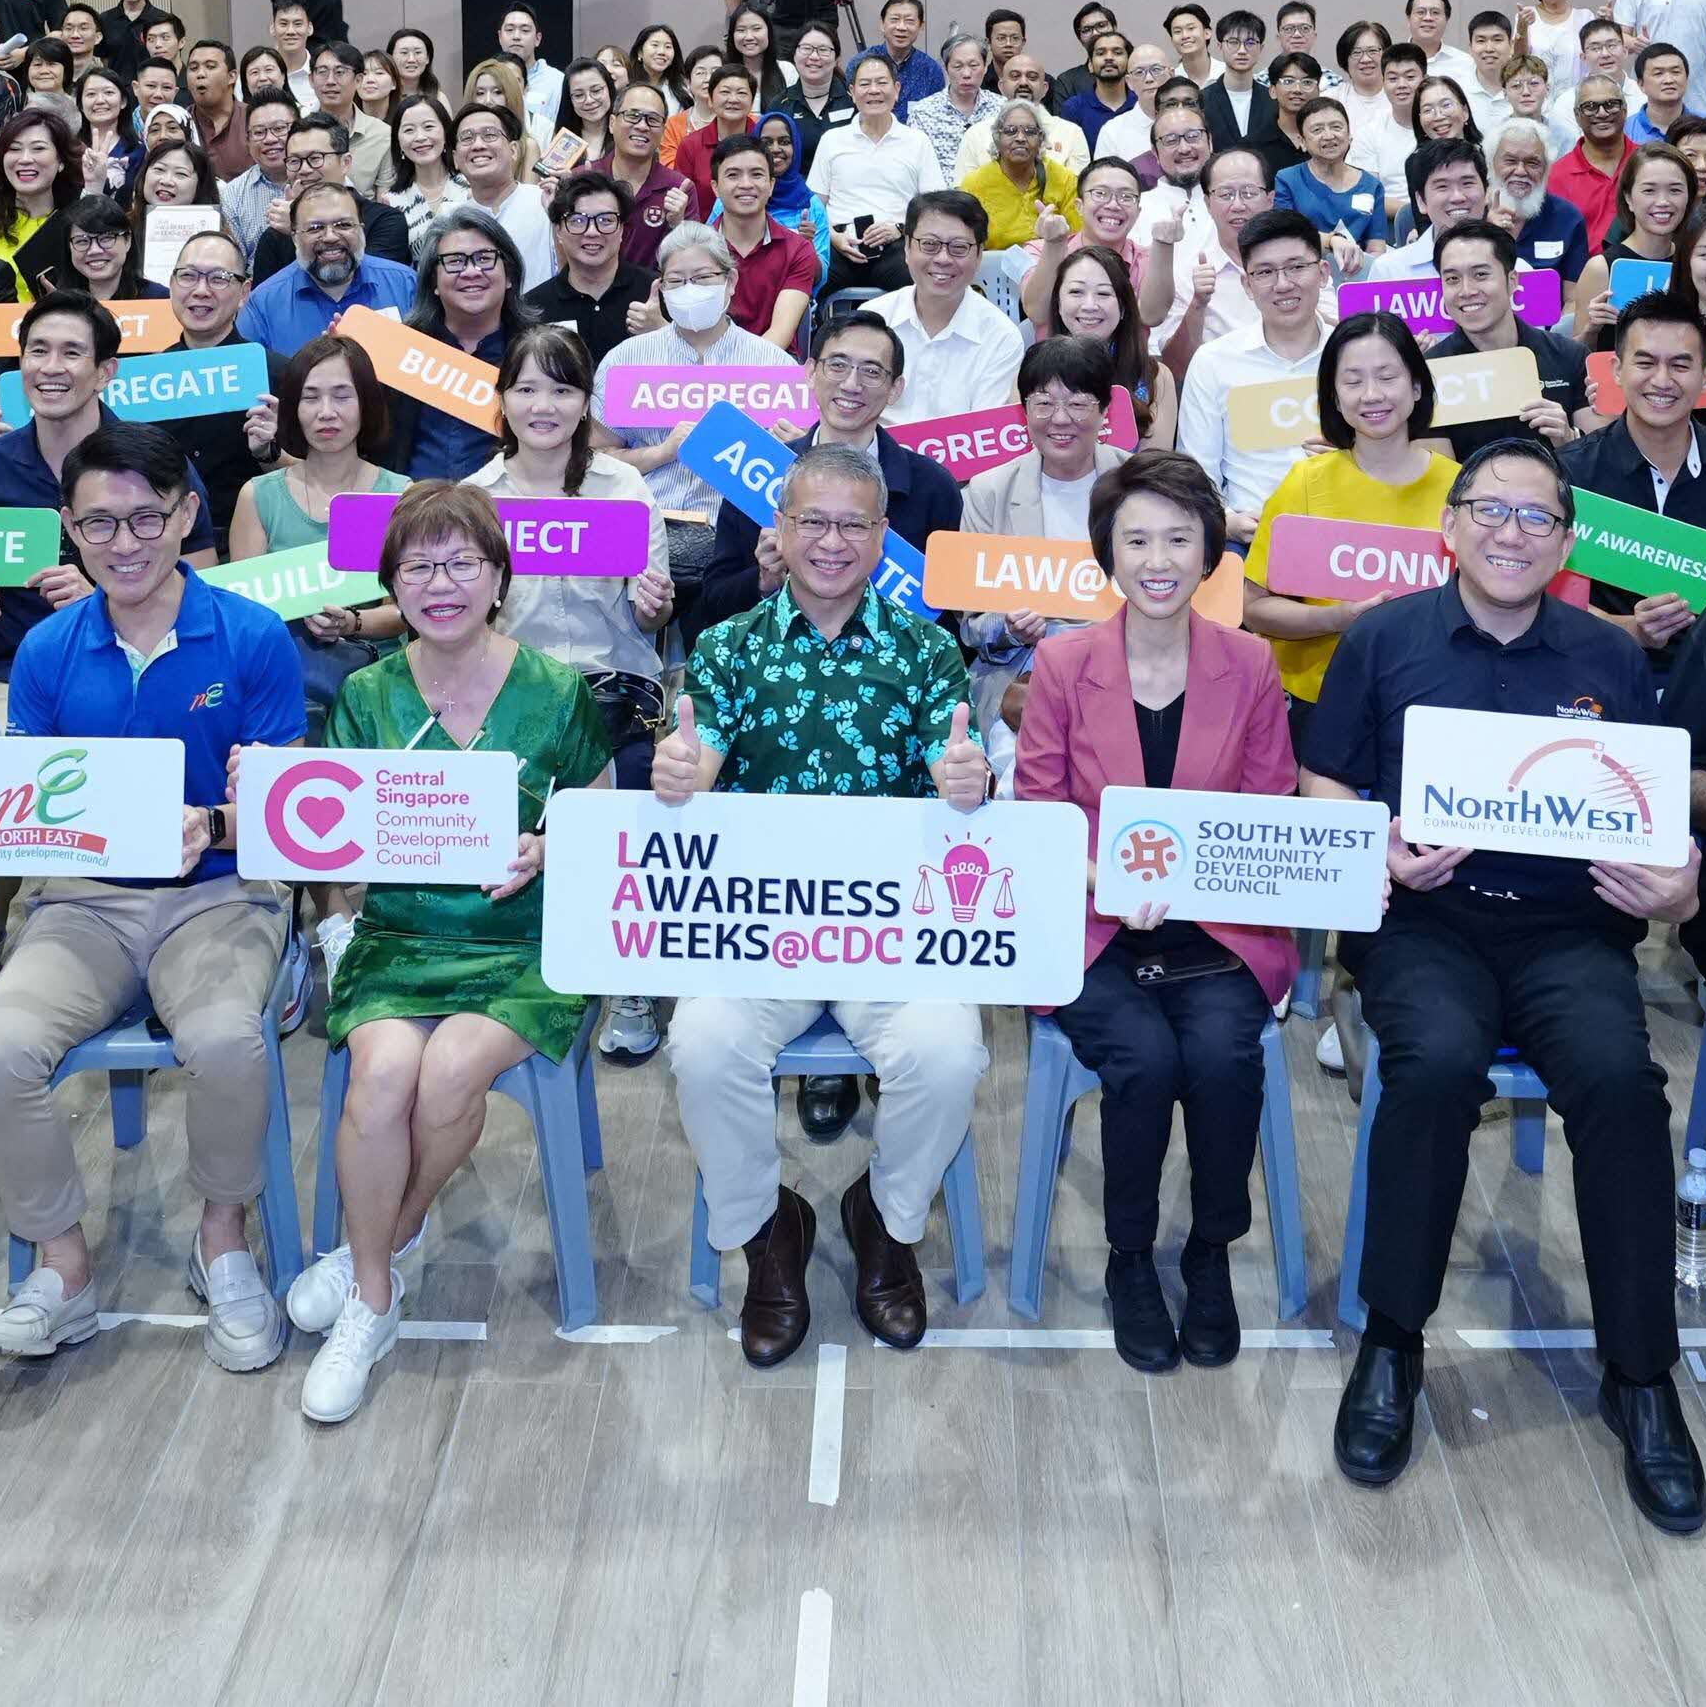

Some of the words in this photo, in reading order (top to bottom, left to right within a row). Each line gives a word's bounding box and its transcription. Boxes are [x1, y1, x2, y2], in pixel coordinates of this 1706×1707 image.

[108, 364, 240, 406] REGATE
[398, 347, 495, 408] BUILD
[631, 381, 812, 411] AGGREGAT
[975, 552, 1111, 601] LAW@
[1329, 544, 1451, 587] CONN
[376, 769, 444, 786] Central
[376, 788, 470, 808] Singapore
[376, 810, 477, 831] Community
[1423, 817, 1495, 831] COMMUNITY
[1502, 823, 1591, 841] DEVELOPMENT
[1598, 833, 1653, 847] COUNCIL
[45, 830, 83, 847] EAST
[377, 829, 490, 850] Development
[1197, 820, 1292, 845] SOUTH
[1300, 827, 1376, 850] WEST
[15, 846, 74, 863] development
[76, 854, 110, 868] council
[376, 849, 441, 865] Council
[617, 831, 719, 870] LAW
[1196, 844, 1326, 865] COMMUNITY
[1195, 860, 1342, 883] DEVELOPMENT
[612, 873, 901, 918] AWARENESS
[1194, 877, 1282, 896] COUNCIL
[612, 920, 904, 969] WEEKS@CDC
[915, 927, 1017, 968] 2025
